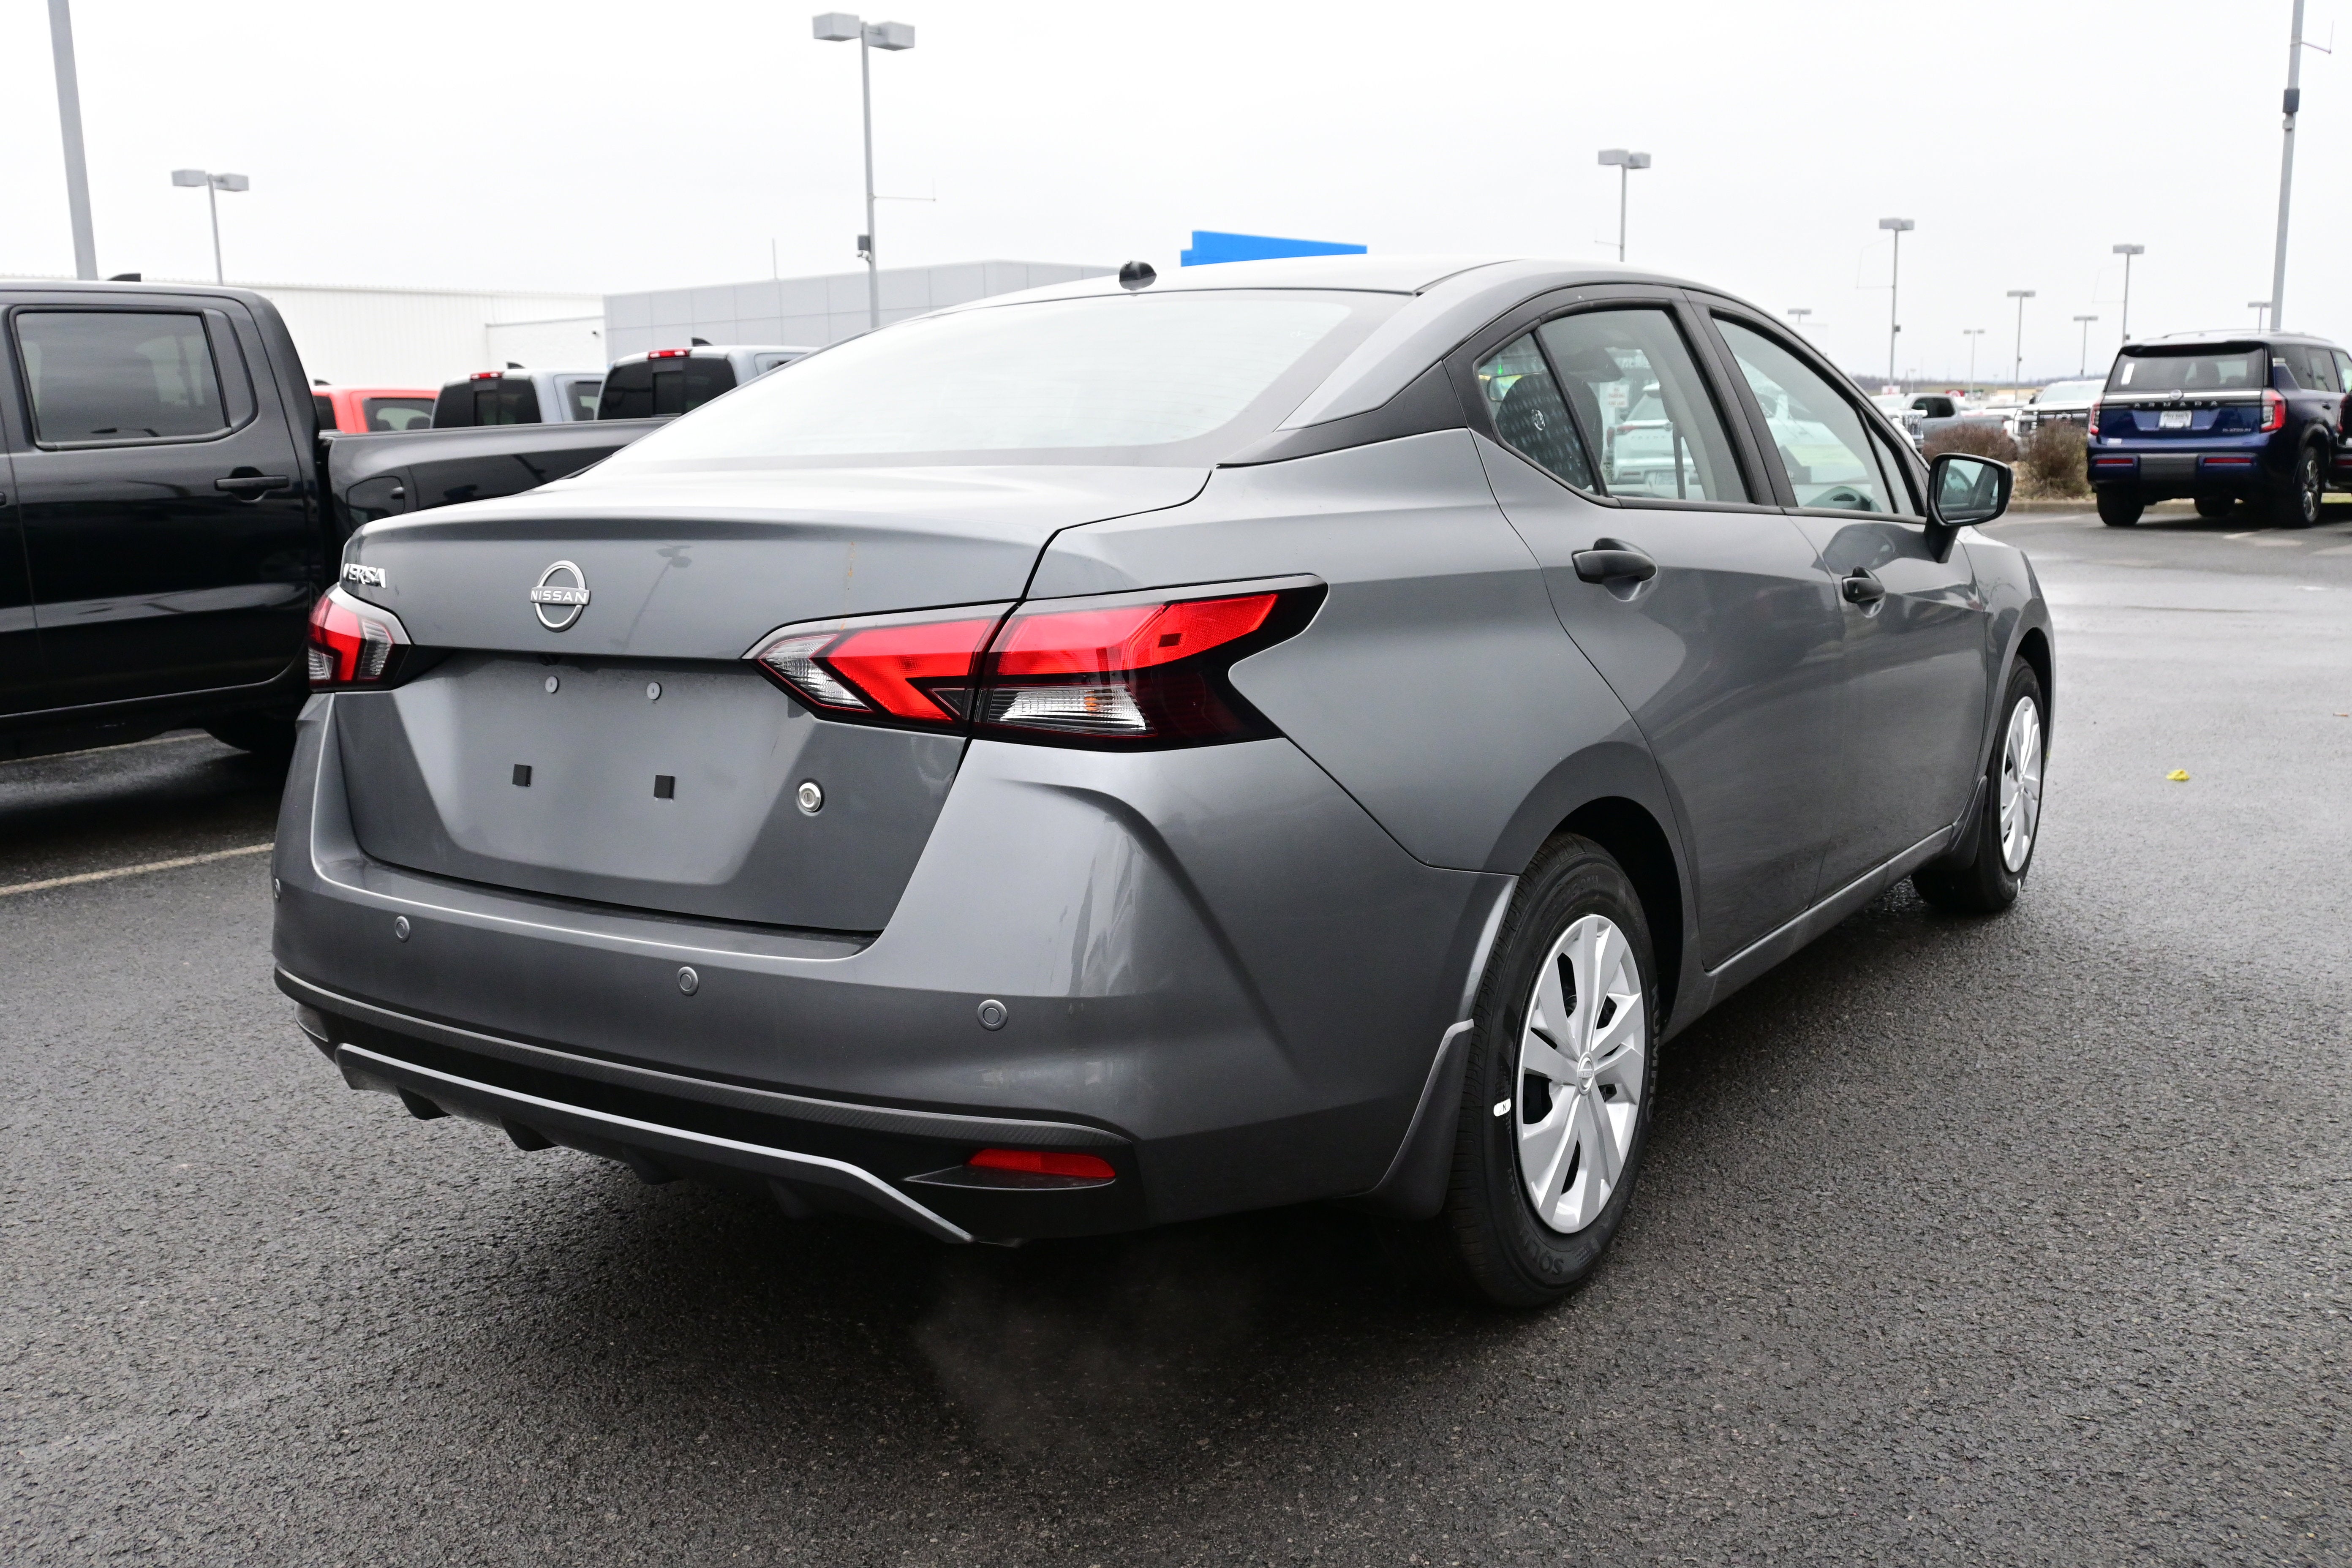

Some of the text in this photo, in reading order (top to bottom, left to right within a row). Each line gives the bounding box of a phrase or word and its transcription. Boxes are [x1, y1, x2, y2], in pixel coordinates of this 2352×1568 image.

[343, 563, 386, 588] VERSA
[530, 590, 587, 603] NISSAN
[1646, 983, 1660, 1123] KUMHO
